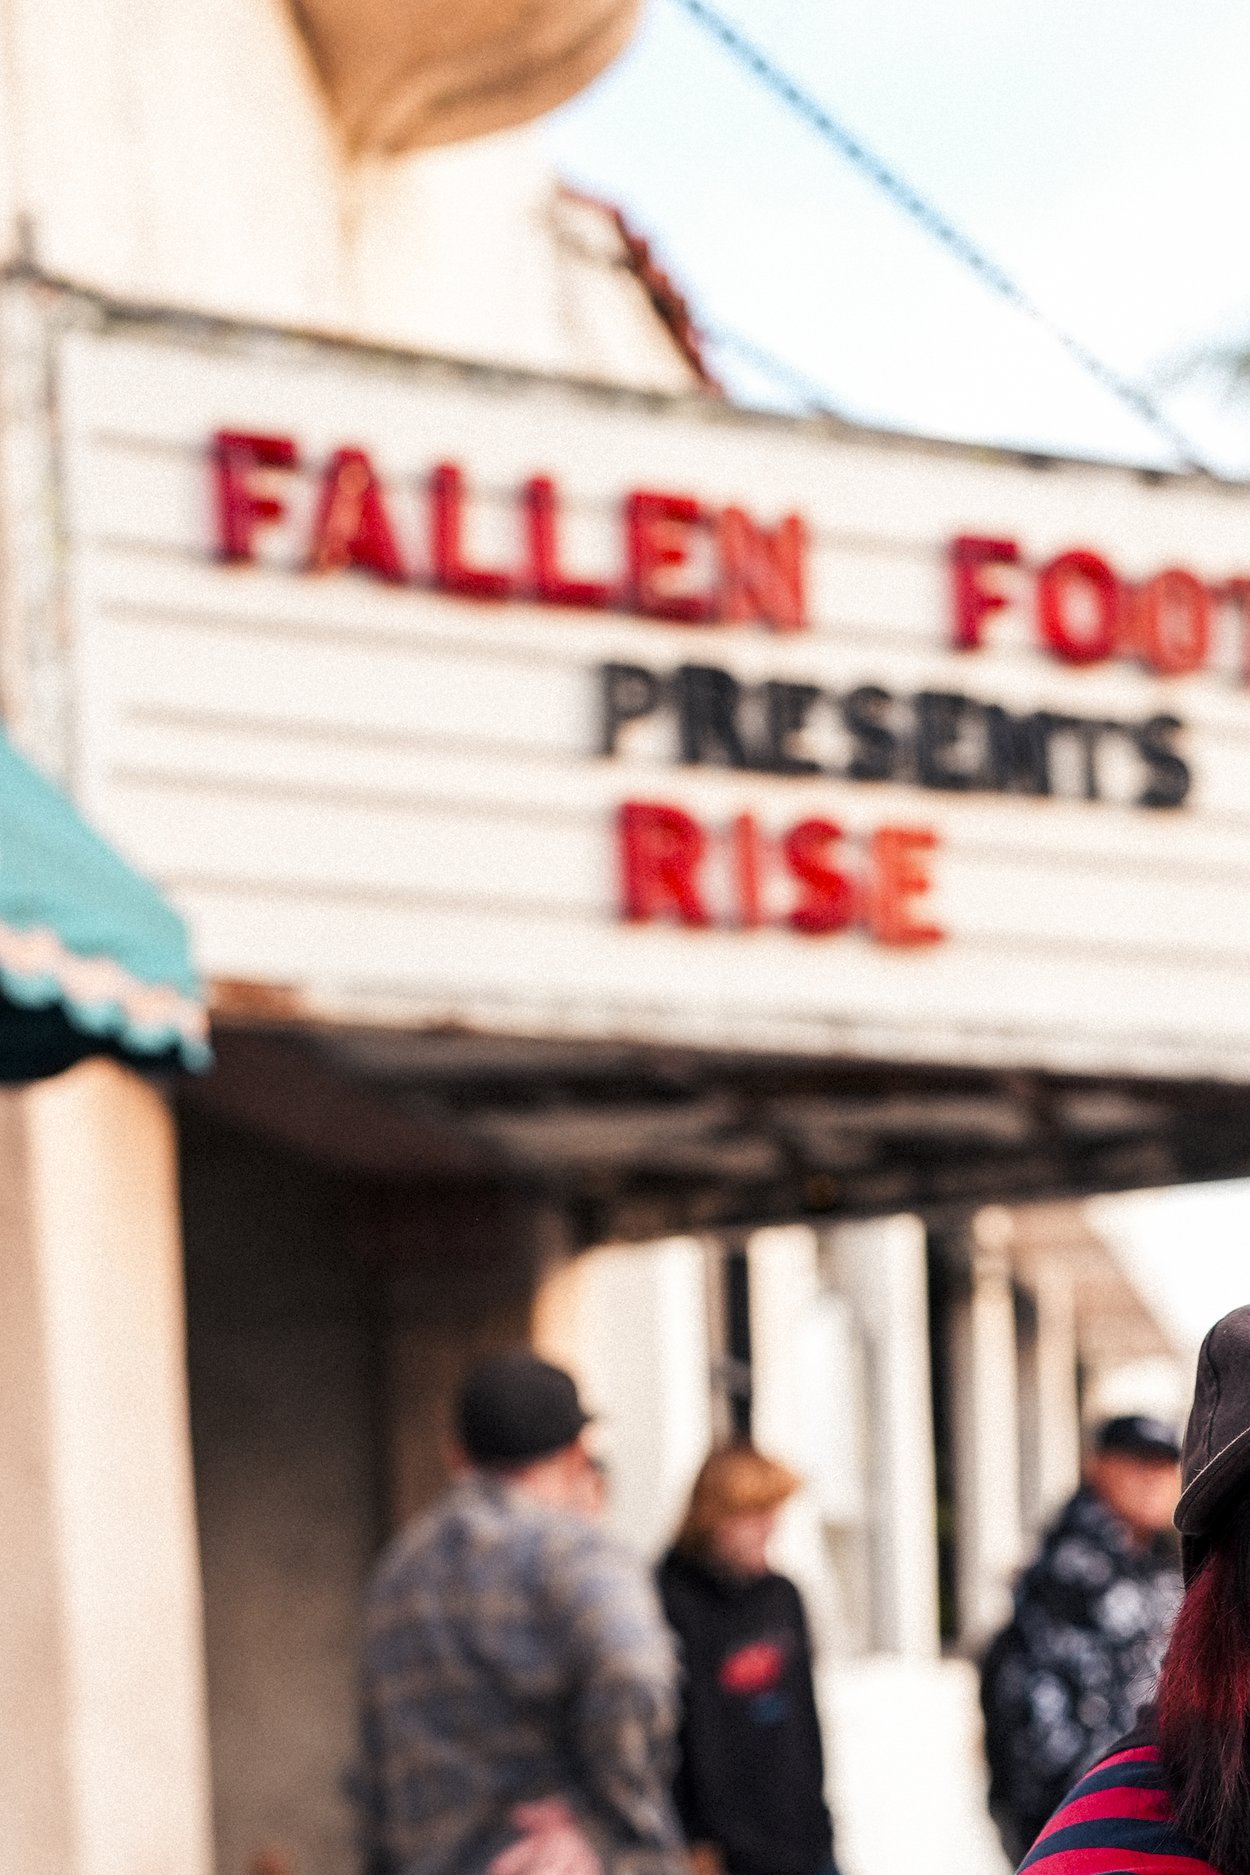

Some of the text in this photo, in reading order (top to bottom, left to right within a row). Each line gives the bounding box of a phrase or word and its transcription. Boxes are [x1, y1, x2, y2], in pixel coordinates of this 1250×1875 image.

[212, 428, 808, 631] FALLEN
[597, 658, 1194, 812] PRESENTS
[614, 798, 947, 949] RISE
